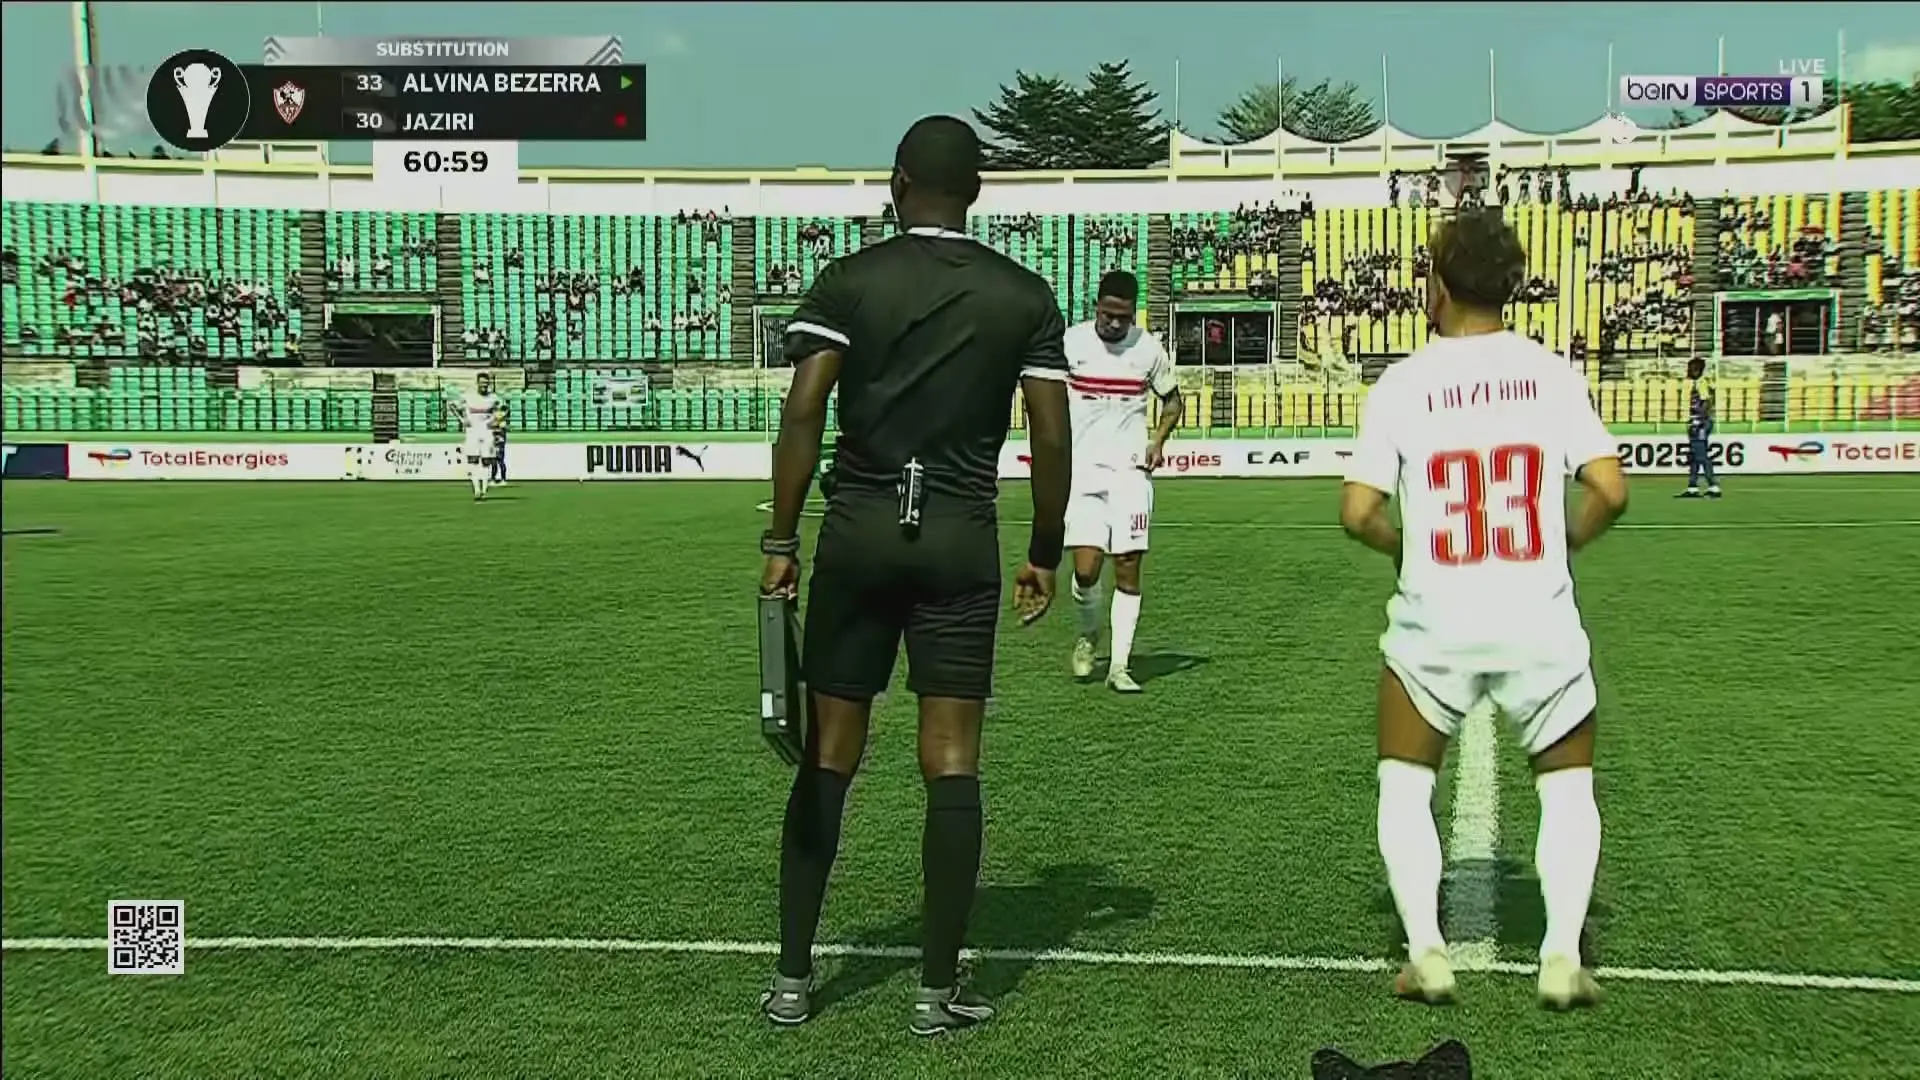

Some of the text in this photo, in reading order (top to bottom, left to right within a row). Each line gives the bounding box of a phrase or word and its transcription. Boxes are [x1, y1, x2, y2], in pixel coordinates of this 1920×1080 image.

[139, 450, 289, 469] TotalEnergies
[586, 445, 672, 473] PUMA
[1247, 451, 1310, 465] CAF
[1428, 444, 1545, 566] 33
